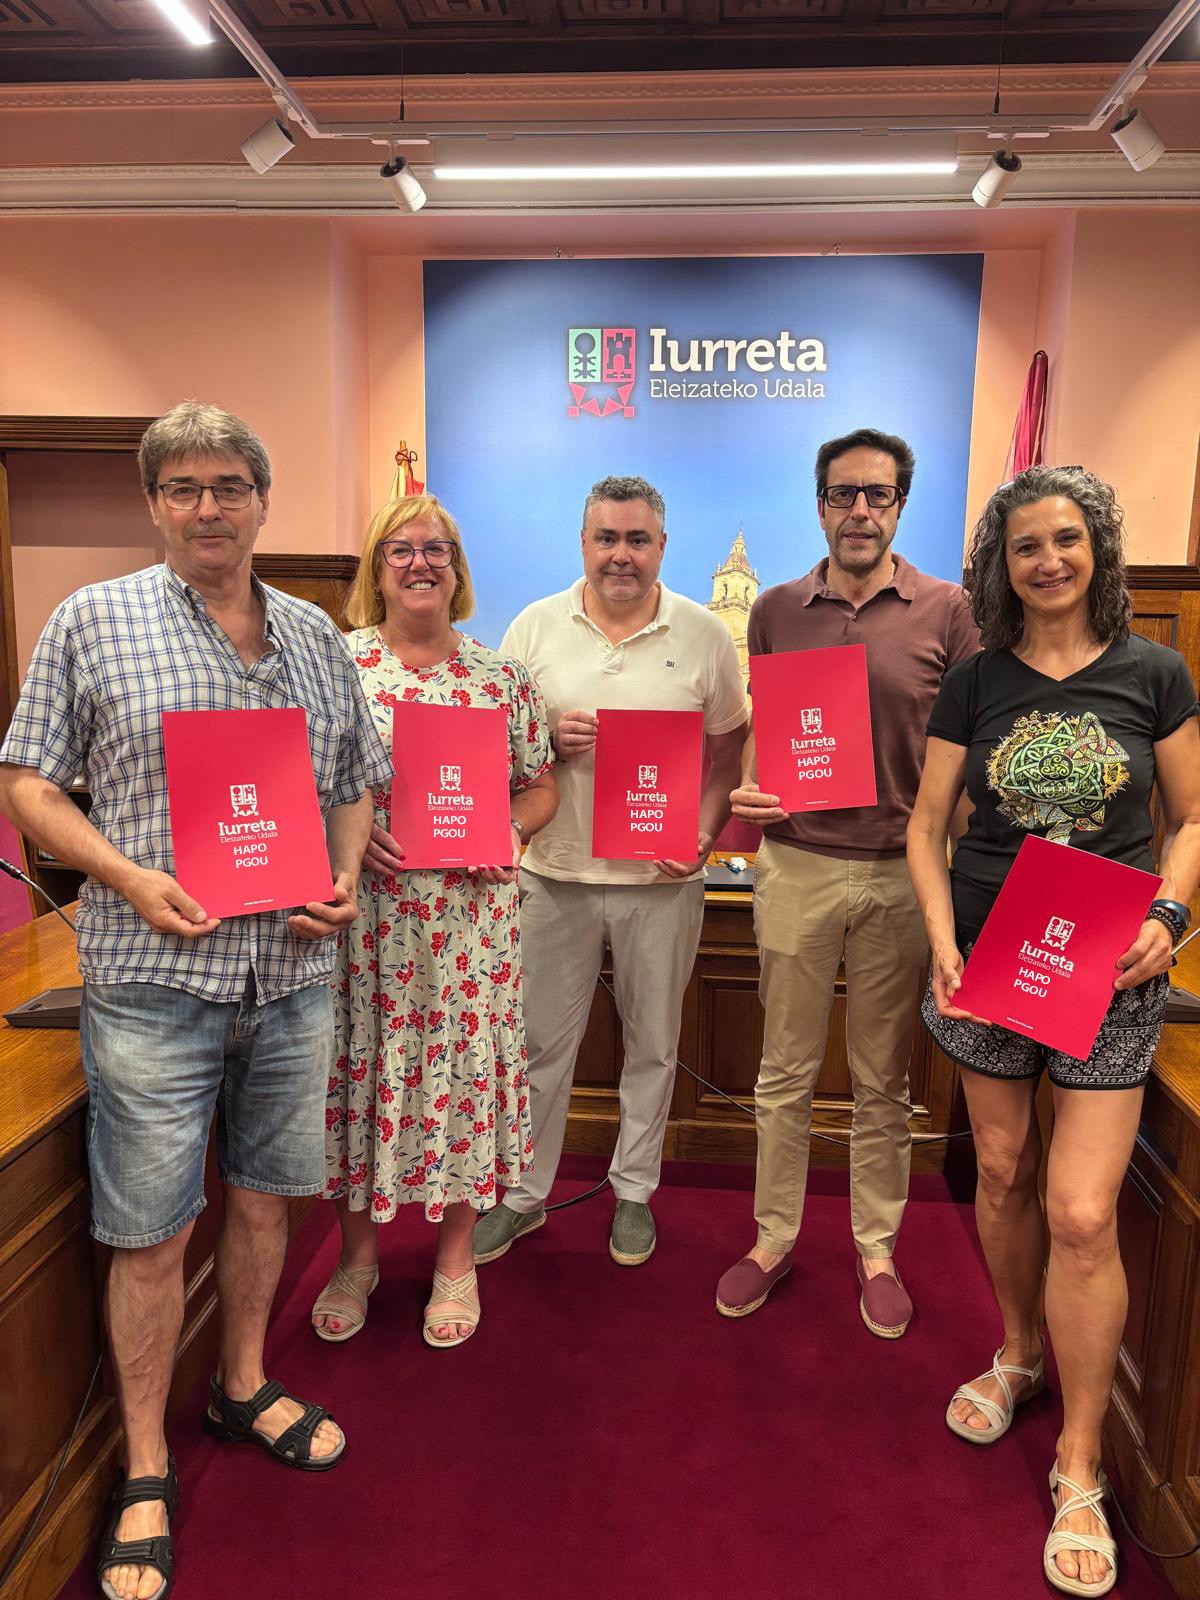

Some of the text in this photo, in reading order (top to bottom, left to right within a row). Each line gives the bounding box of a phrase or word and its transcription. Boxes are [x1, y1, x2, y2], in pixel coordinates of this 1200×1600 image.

[649, 328, 827, 372] Iurreta
[649, 378, 826, 398] Eleizateko Udala
[791, 736, 837, 750] Iurreta
[797, 754, 830, 768] HAPO
[798, 767, 832, 781] PGOU
[427, 792, 474, 806] Iurreta
[626, 790, 668, 803] Iurreta
[433, 815, 467, 825] HAPO
[630, 809, 664, 819] HAPO
[217, 819, 278, 836] Iurreta
[433, 828, 466, 838] PGOU
[630, 822, 663, 832] PGOU
[233, 843, 267, 856] HAPO
[235, 856, 269, 869] PGOU
[1020, 940, 1075, 973] Iurreta
[1018, 966, 1051, 985] HAPO
[1013, 978, 1048, 998] PGOU
